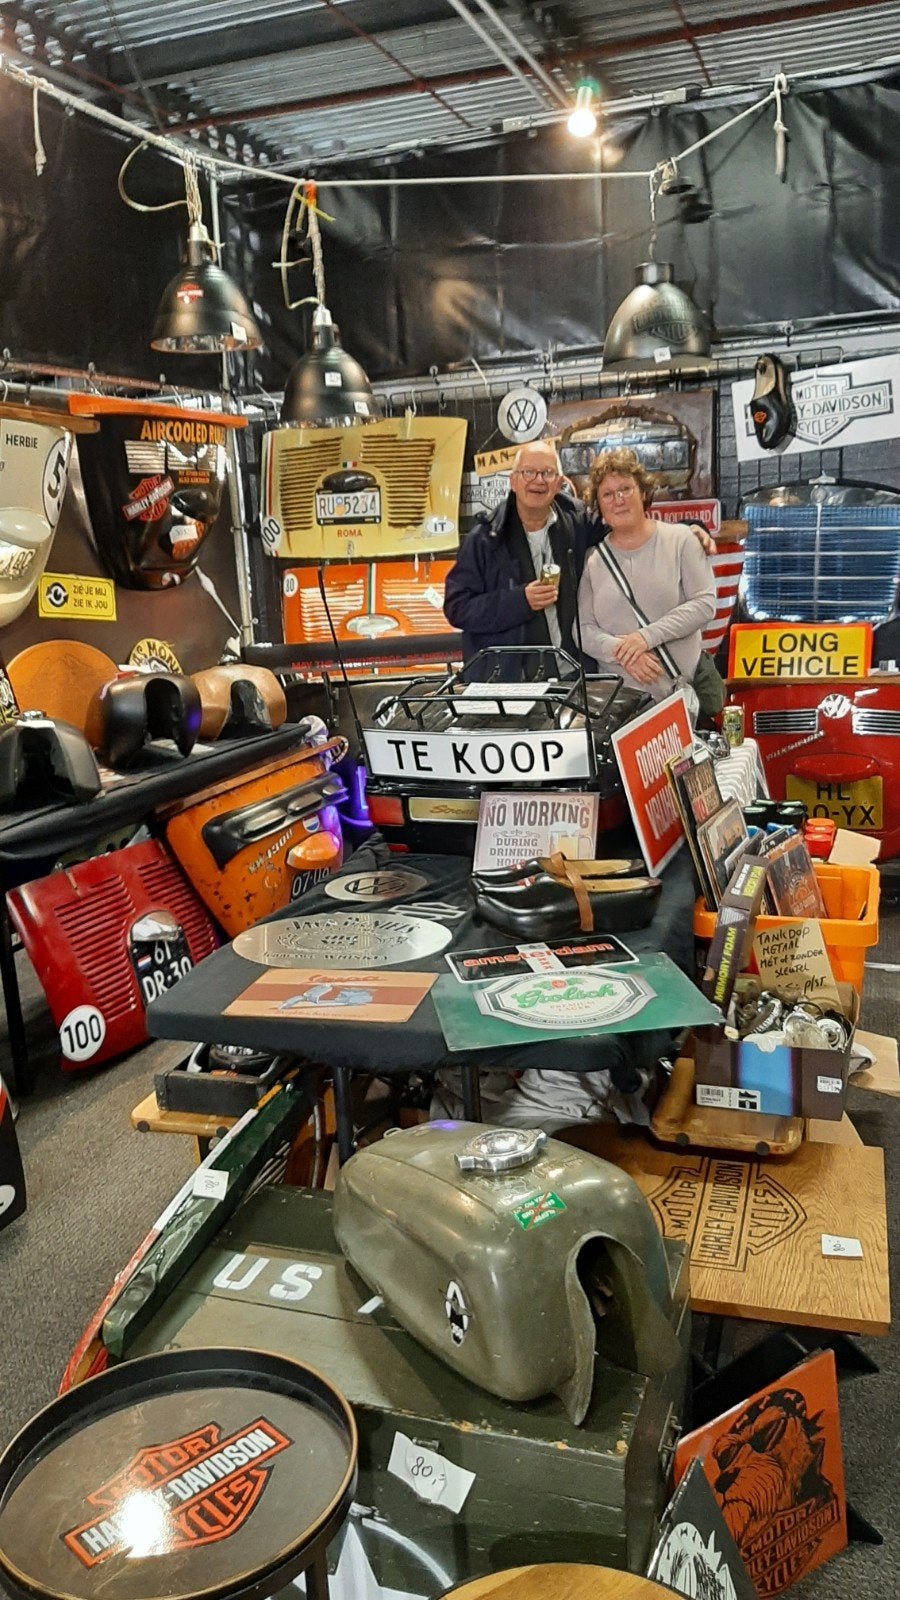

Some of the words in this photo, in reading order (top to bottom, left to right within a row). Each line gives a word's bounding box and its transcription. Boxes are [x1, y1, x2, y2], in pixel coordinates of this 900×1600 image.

[794, 383, 838, 400] MOTOR
[5, 433, 38, 449] HERBIE
[140, 419, 208, 444] AIRCOOLED
[261, 518, 281, 550] 100
[337, 528, 362, 538] ROMA
[433, 522, 446, 532] IT
[761, 632, 839, 654] LONG
[741, 655, 859, 677] VEHICLE
[387, 739, 434, 772] TE
[451, 740, 564, 775] KOOP
[484, 803, 507, 828] NO
[512, 800, 591, 829] WORKING
[489, 847, 544, 857] DRINKING
[495, 837, 538, 847] DURING
[153, 939, 171, 965] 61
[462, 942, 615, 968] amsterdam
[714, 947, 732, 1003] MEMORY
[725, 926, 737, 948] FOAM
[63, 1014, 102, 1054] 100
[662, 1180, 699, 1231] MOTOR
[699, 1161, 746, 1263] HARLEY-DAVIDSON
[748, 1188, 791, 1244] CYCLES
[750, 1508, 807, 1554] MOTOR
